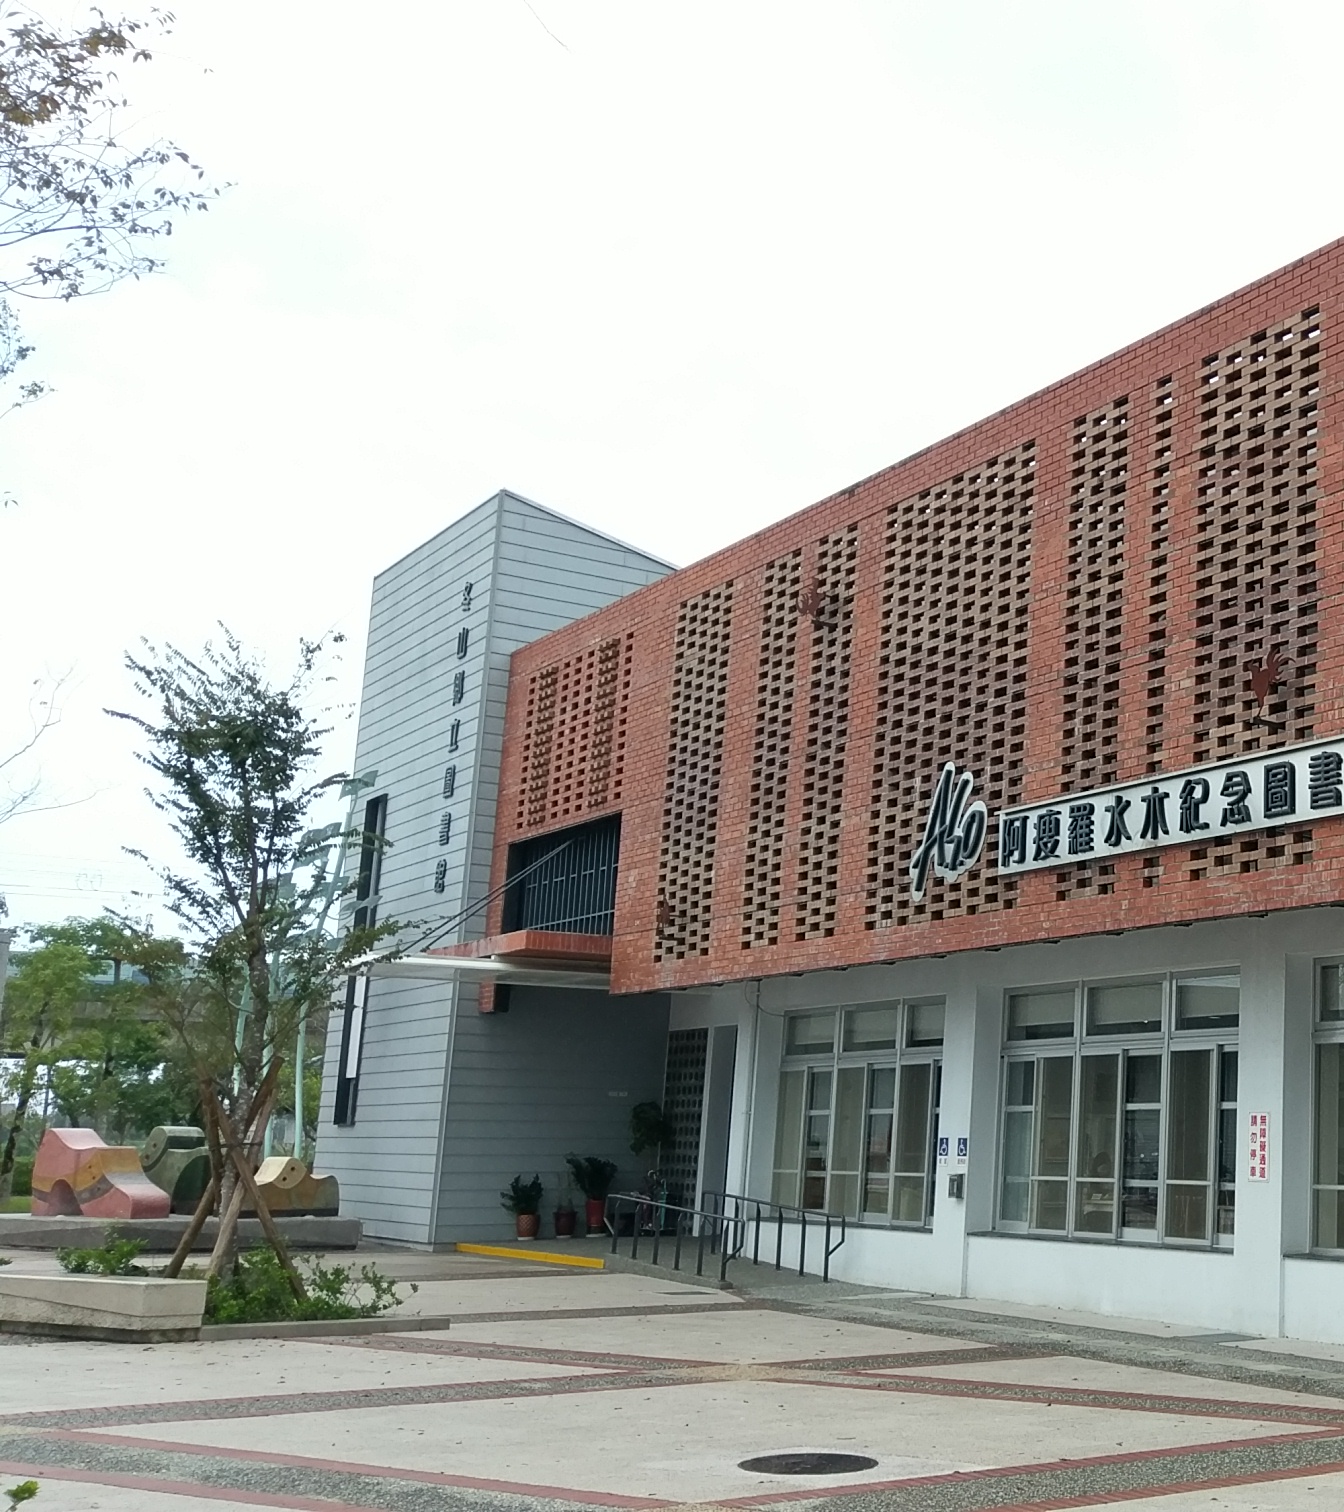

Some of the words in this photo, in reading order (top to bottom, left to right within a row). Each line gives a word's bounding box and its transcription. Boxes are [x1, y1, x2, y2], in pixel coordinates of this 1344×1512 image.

[1249, 1114, 1258, 1177] 請勿停車
[1259, 1114, 1267, 1179] 無障礙通道
